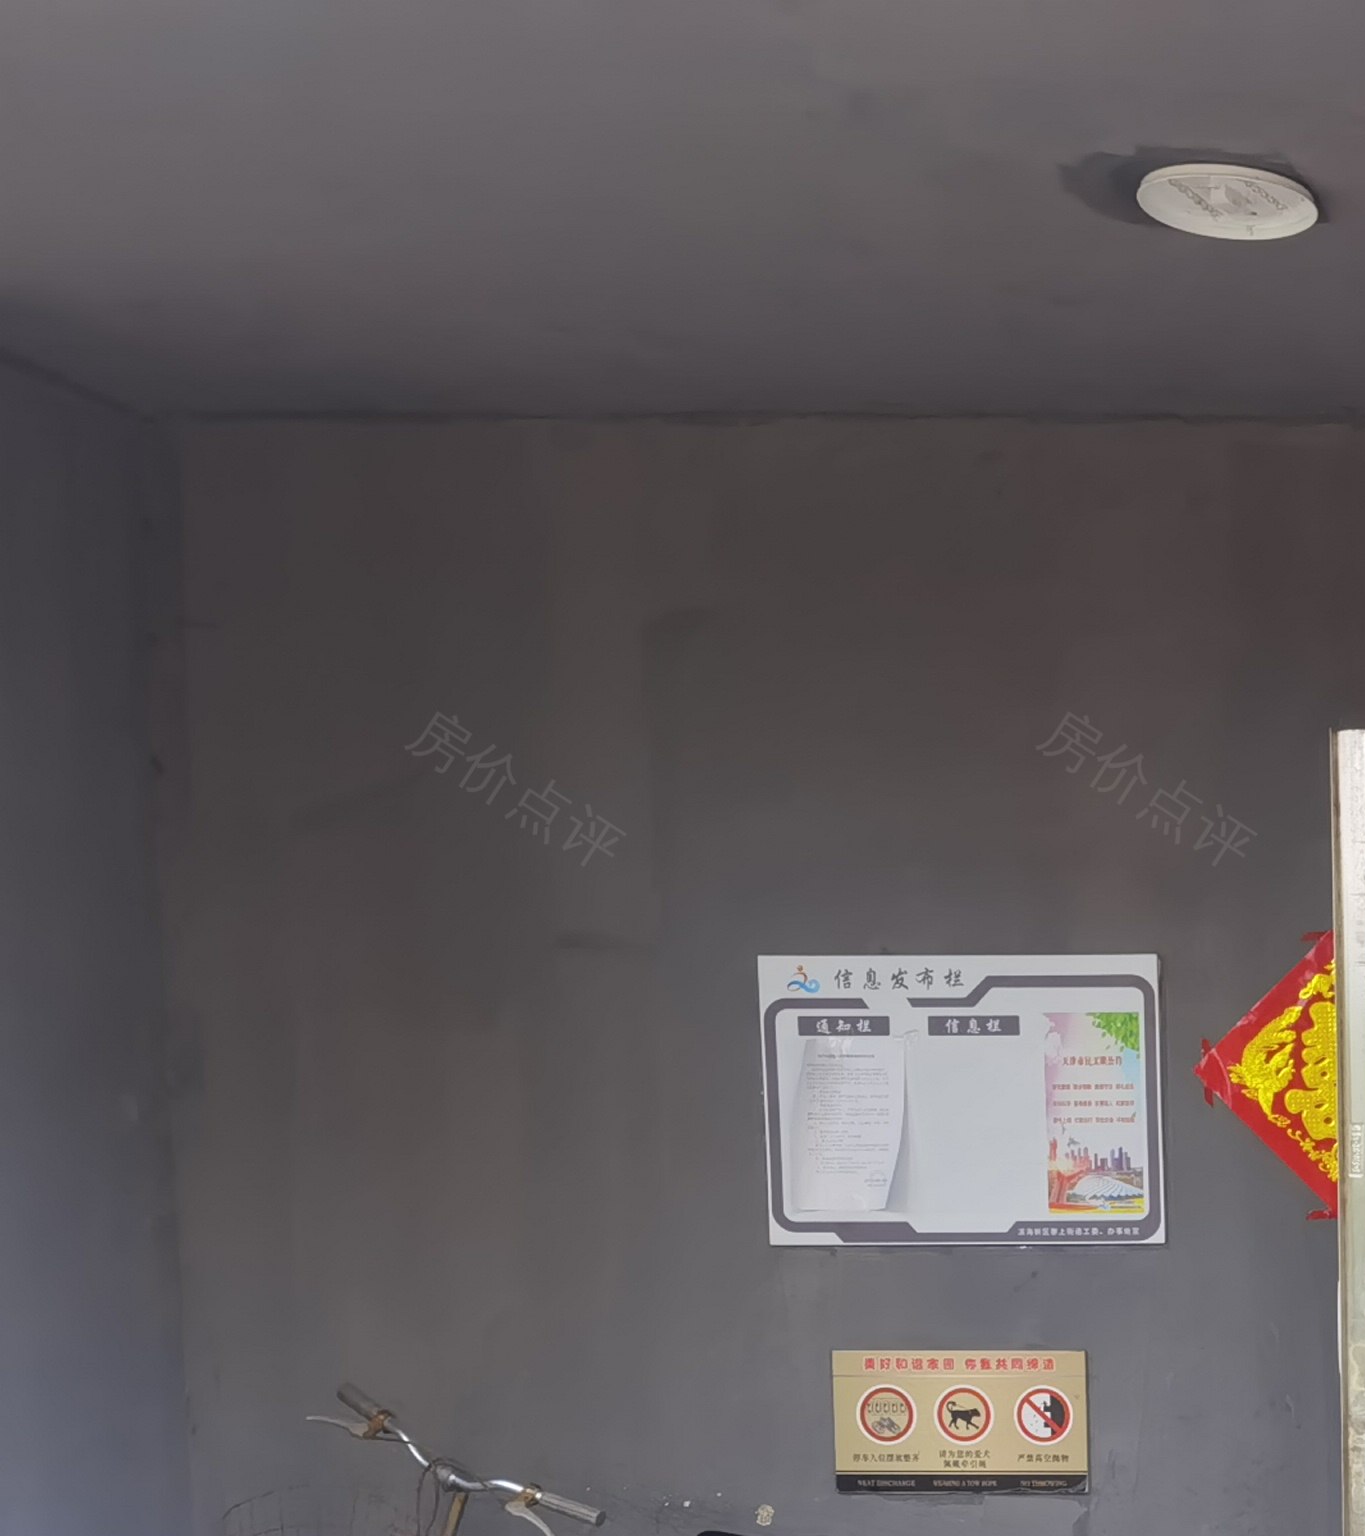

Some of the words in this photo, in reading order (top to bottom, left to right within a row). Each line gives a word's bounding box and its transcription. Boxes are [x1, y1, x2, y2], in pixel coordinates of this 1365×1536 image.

[834, 967, 965, 991] 信息发布栏
[816, 1018, 872, 1034] 通知栏
[945, 1018, 1002, 1034] 信息栏
